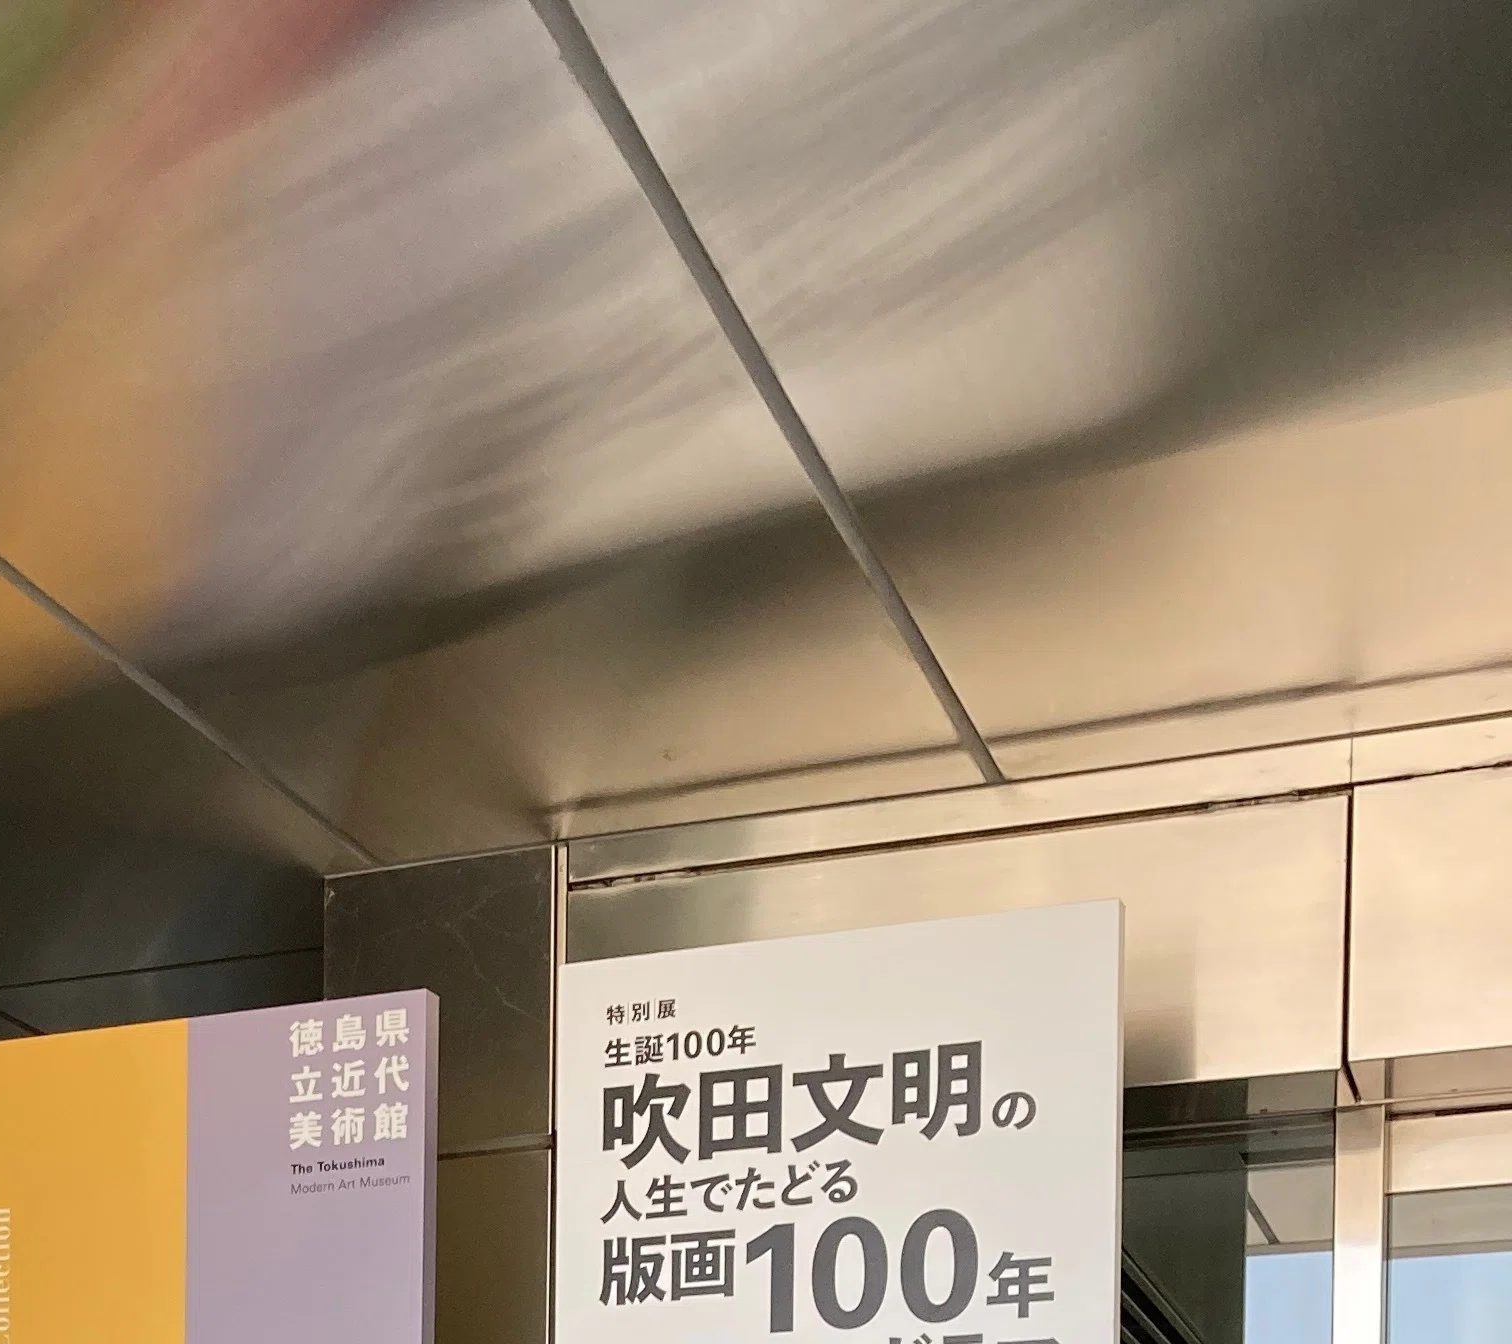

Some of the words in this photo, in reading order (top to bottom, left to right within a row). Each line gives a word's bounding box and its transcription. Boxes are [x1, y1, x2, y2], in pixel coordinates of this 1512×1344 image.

[289, 1008, 410, 1058] 徳島県
[604, 1024, 757, 1068] 生誕100年
[289, 1056, 410, 1104] 立近代
[289, 1103, 409, 1150] 美術館
[602, 1040, 1037, 1169] 吹田文明の
[291, 1163, 313, 1177] The
[317, 1156, 385, 1174] Tokushima
[291, 1180, 335, 1195] Modern
[339, 1178, 356, 1192] Art
[360, 1174, 410, 1190] Museum
[600, 1159, 859, 1224] 人生でたどる
[599, 1209, 1055, 1334] 版画100年
